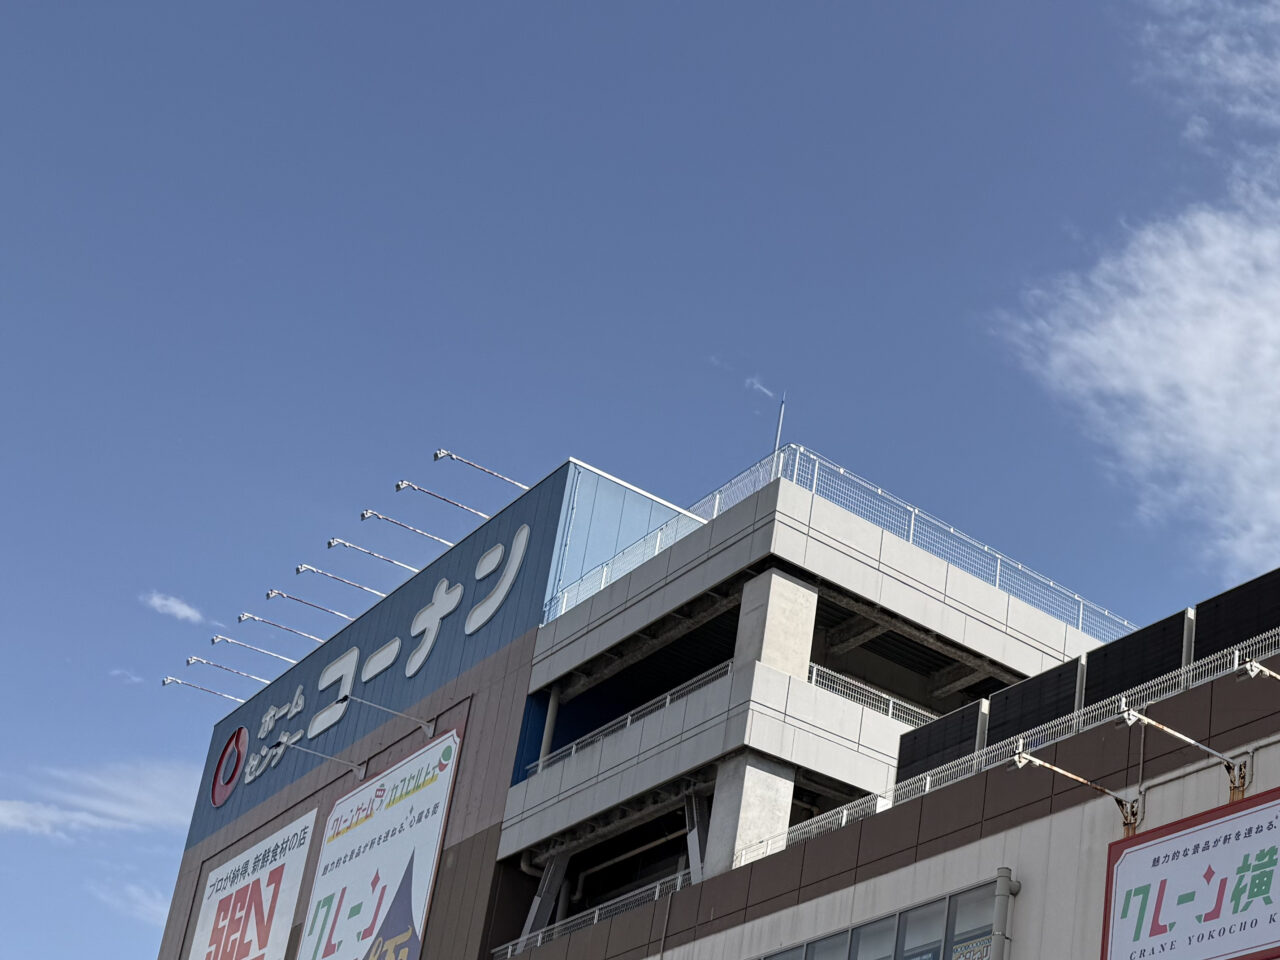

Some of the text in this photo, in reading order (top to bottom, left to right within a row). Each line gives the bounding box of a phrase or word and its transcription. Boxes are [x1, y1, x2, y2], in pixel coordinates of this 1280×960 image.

[307, 523, 530, 739] コーナン
[258, 685, 304, 739] ホーム
[245, 729, 304, 785] センター
[208, 825, 310, 900] プロが納得、新鮮食材の店
[1187, 918, 1259, 947] YOKOCHO
